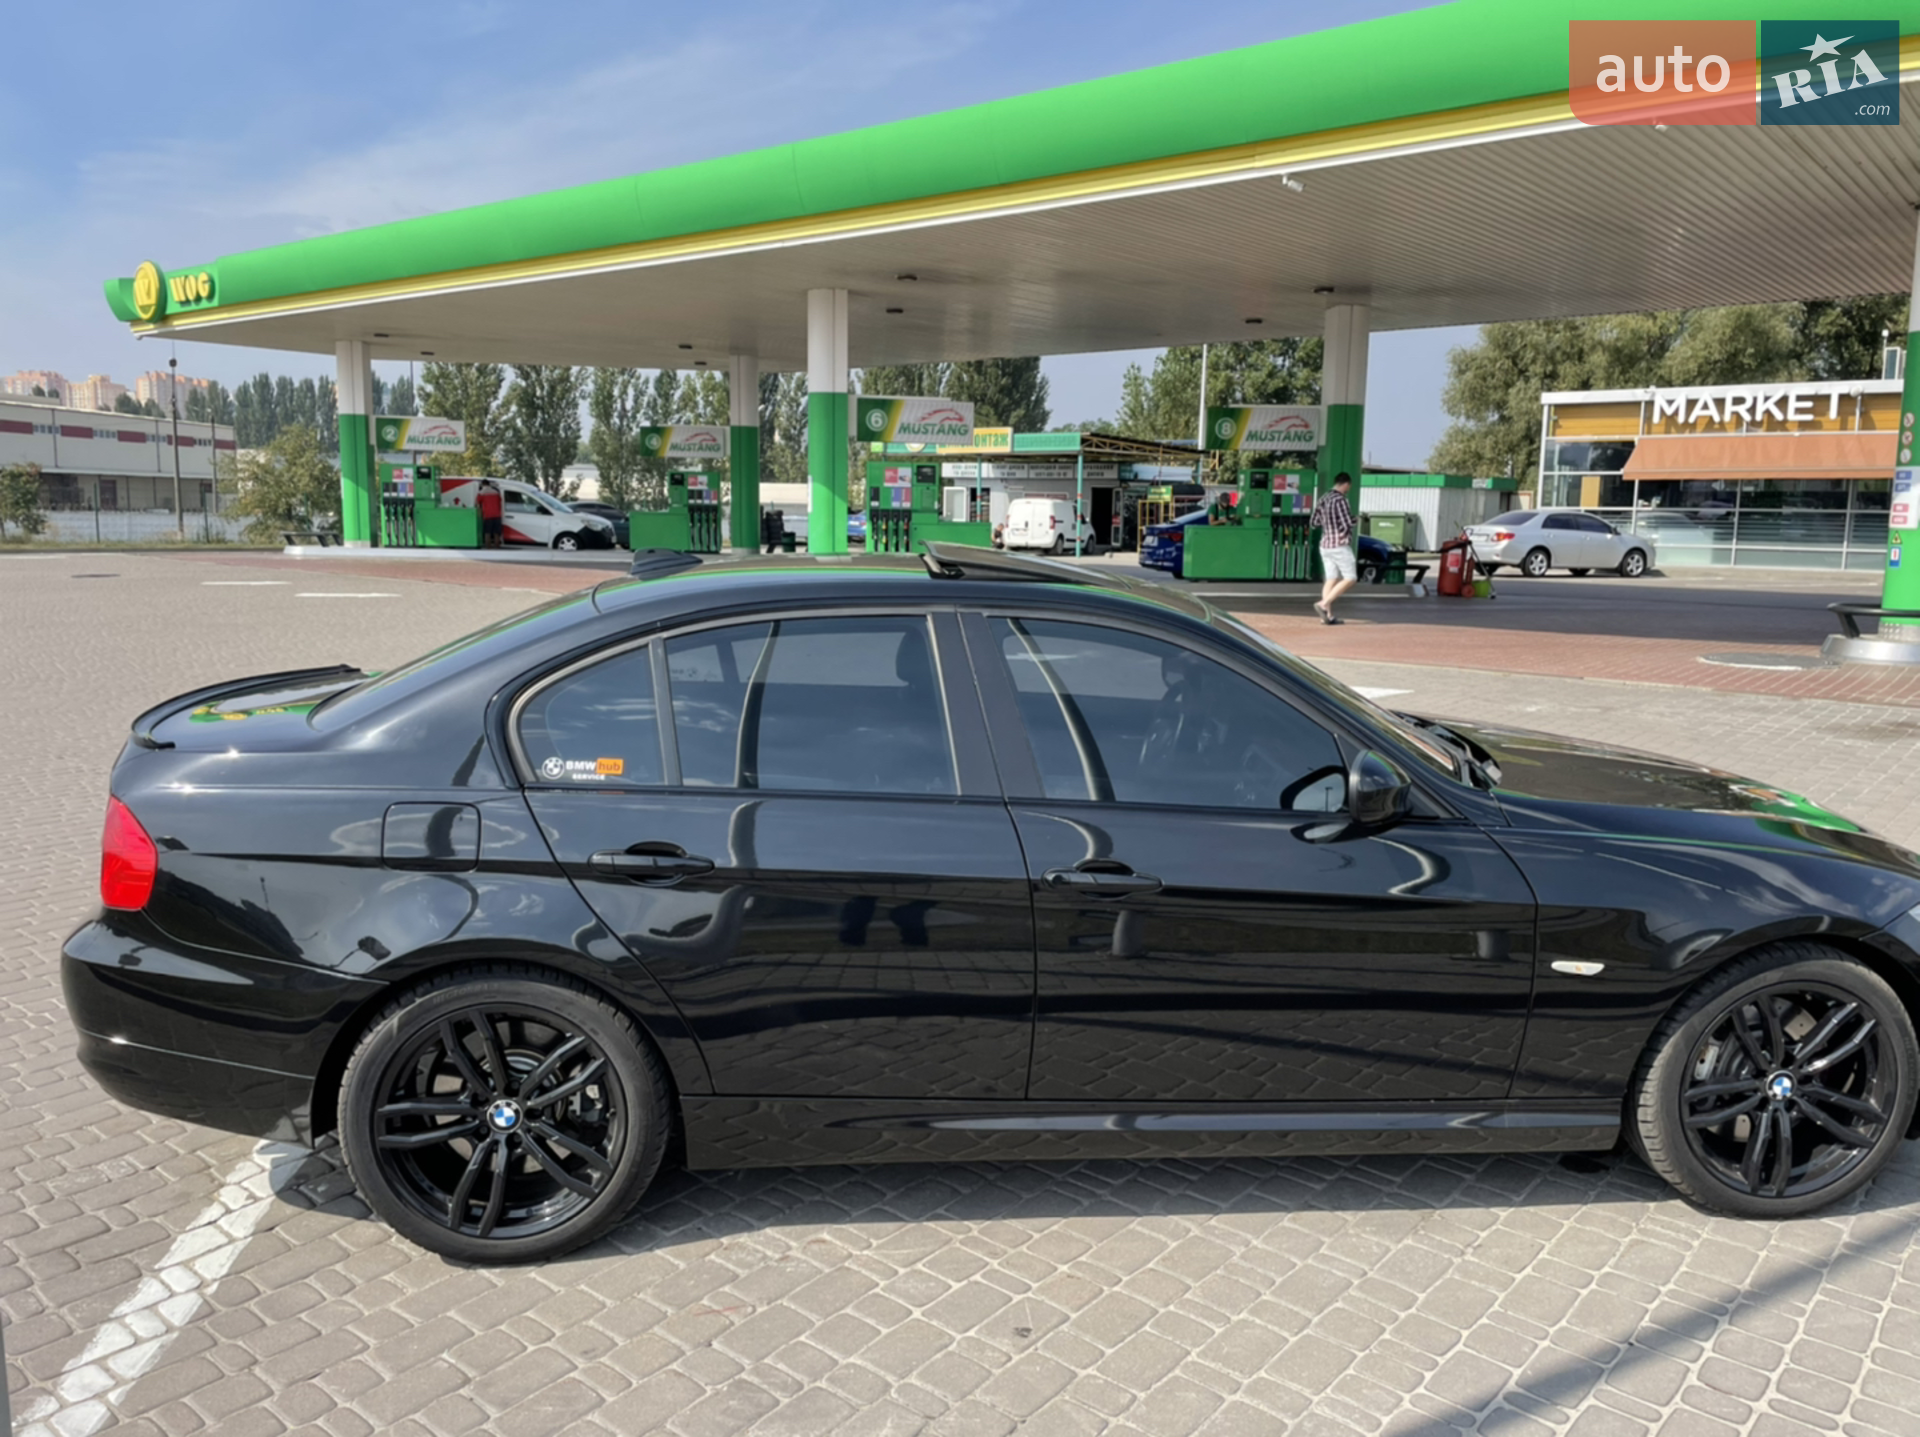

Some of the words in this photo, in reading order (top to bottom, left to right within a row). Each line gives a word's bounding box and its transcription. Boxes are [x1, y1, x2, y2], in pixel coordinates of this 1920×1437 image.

[169, 271, 211, 302] WOG
[1652, 387, 1850, 425] MARKET
[870, 412, 883, 428] 6
[386, 428, 395, 439] 2
[898, 422, 969, 436] MUSTANG
[1221, 421, 1232, 436] 8
[407, 434, 461, 446] MUSTANG
[1245, 429, 1314, 442] MUSTANG
[669, 442, 721, 453] MUSTANG
[566, 760, 597, 771] BMW
[598, 761, 621, 772] hub
